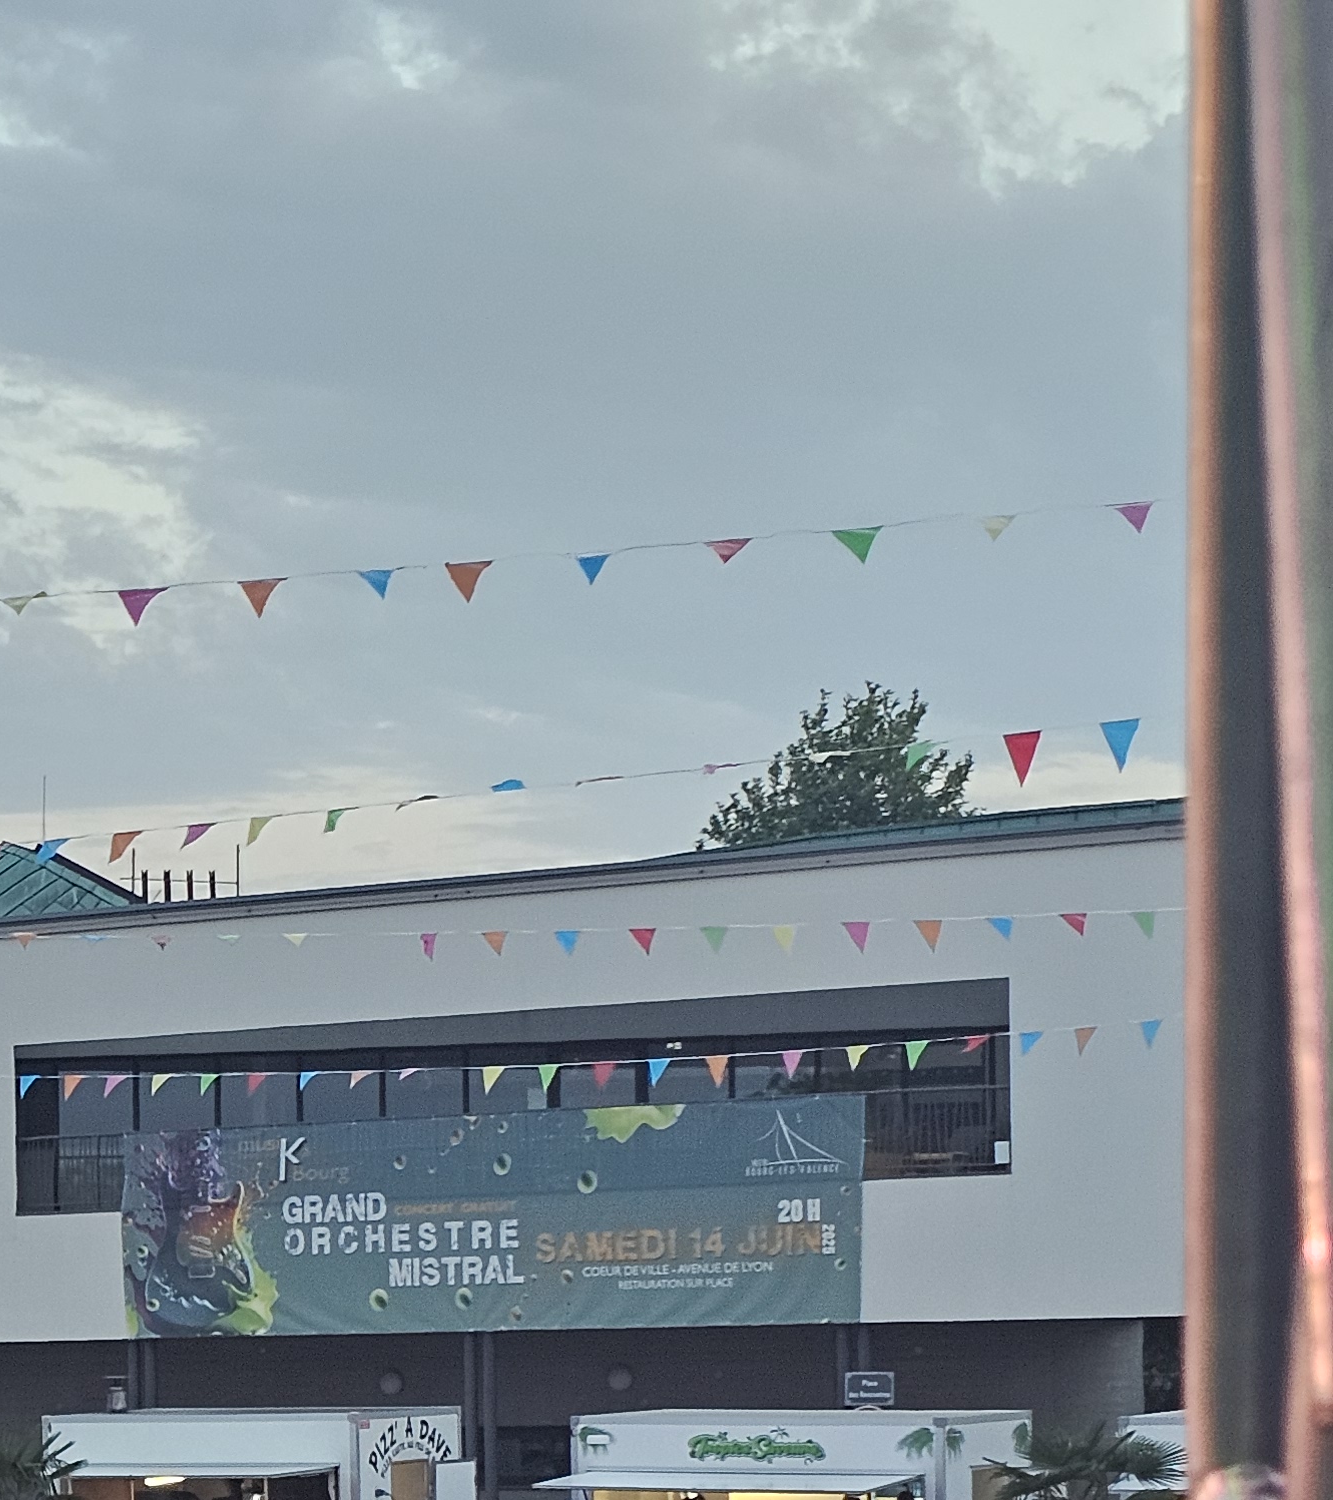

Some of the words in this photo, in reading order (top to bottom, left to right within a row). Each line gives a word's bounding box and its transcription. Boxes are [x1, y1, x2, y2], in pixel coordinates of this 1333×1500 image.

[282, 1191, 389, 1225] GRAND
[776, 1198, 804, 1223] 20
[806, 1197, 822, 1222] H
[283, 1217, 521, 1256] ORCHESTRE
[534, 1227, 679, 1264] SAMEDI
[688, 1225, 726, 1260] 14
[736, 1223, 822, 1258] JUIN
[387, 1254, 526, 1288] MISTRAL
[581, 1265, 622, 1278] COEUR
[623, 1265, 639, 1277] DE
[639, 1263, 670, 1276] VILLE
[677, 1262, 722, 1275] AVENUE
[723, 1261, 740, 1274] DE
[741, 1260, 774, 1274] LYON
